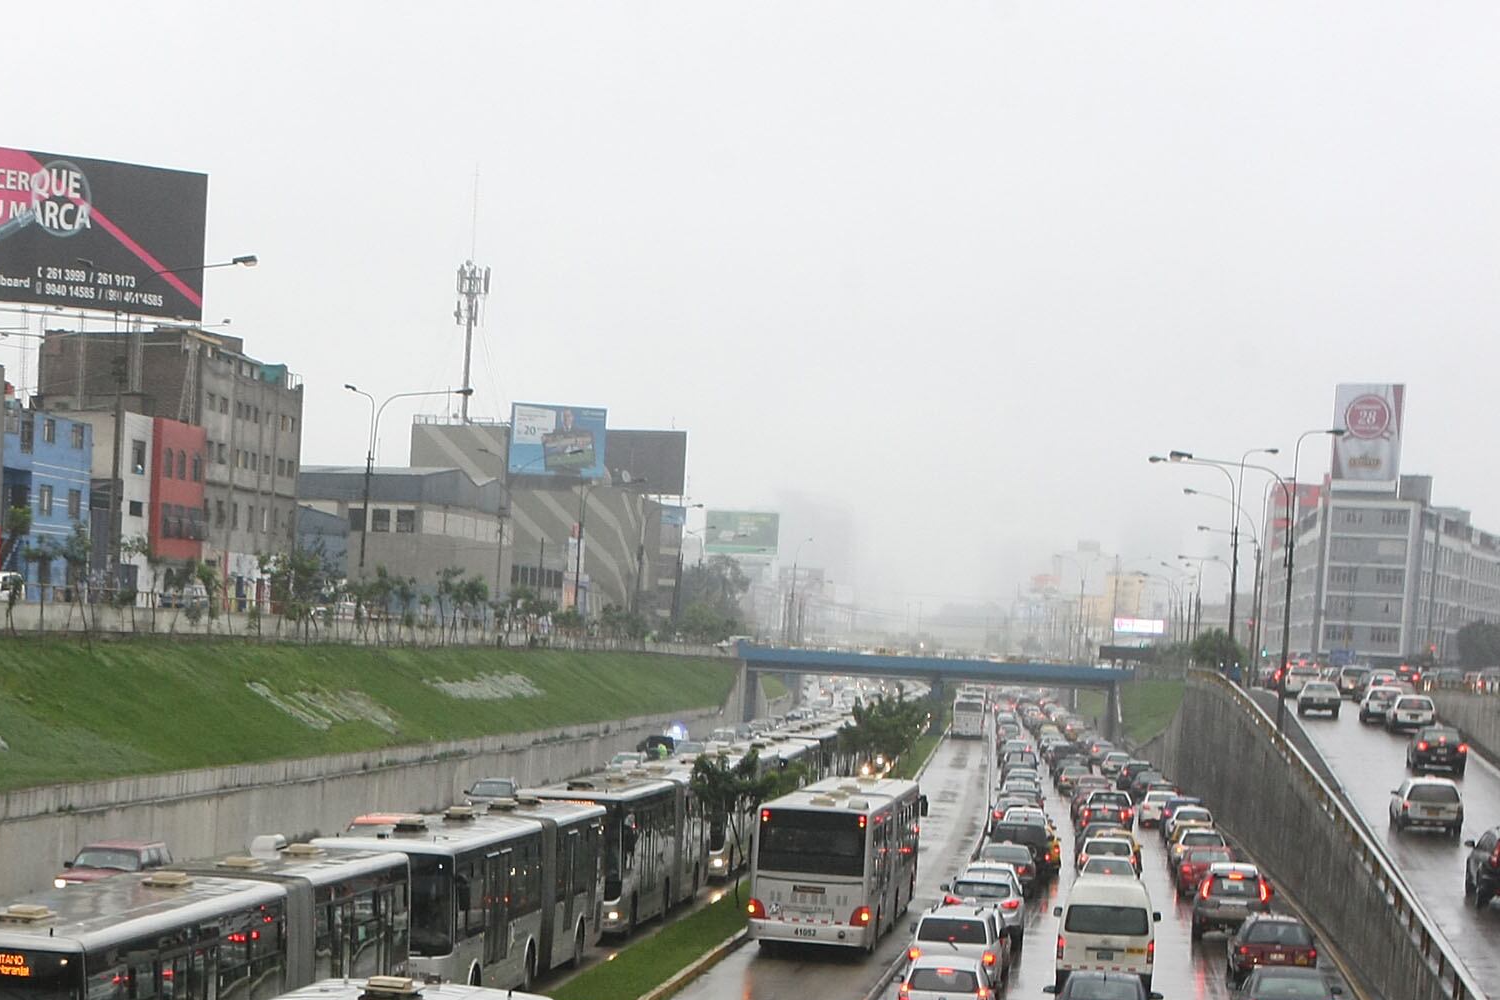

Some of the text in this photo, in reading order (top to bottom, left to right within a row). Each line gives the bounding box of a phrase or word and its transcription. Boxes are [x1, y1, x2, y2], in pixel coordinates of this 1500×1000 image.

[8, 200, 92, 230] MARCA
[46, 267, 63, 280] 261
[64, 268, 86, 283] 3999
[97, 272, 113, 286] 261
[114, 273, 136, 288] 9173
[45, 282, 67, 297] 9940
[69, 284, 95, 299] 14585
[1358, 410, 1377, 425] 28
[794, 928, 817, 937] 41052
